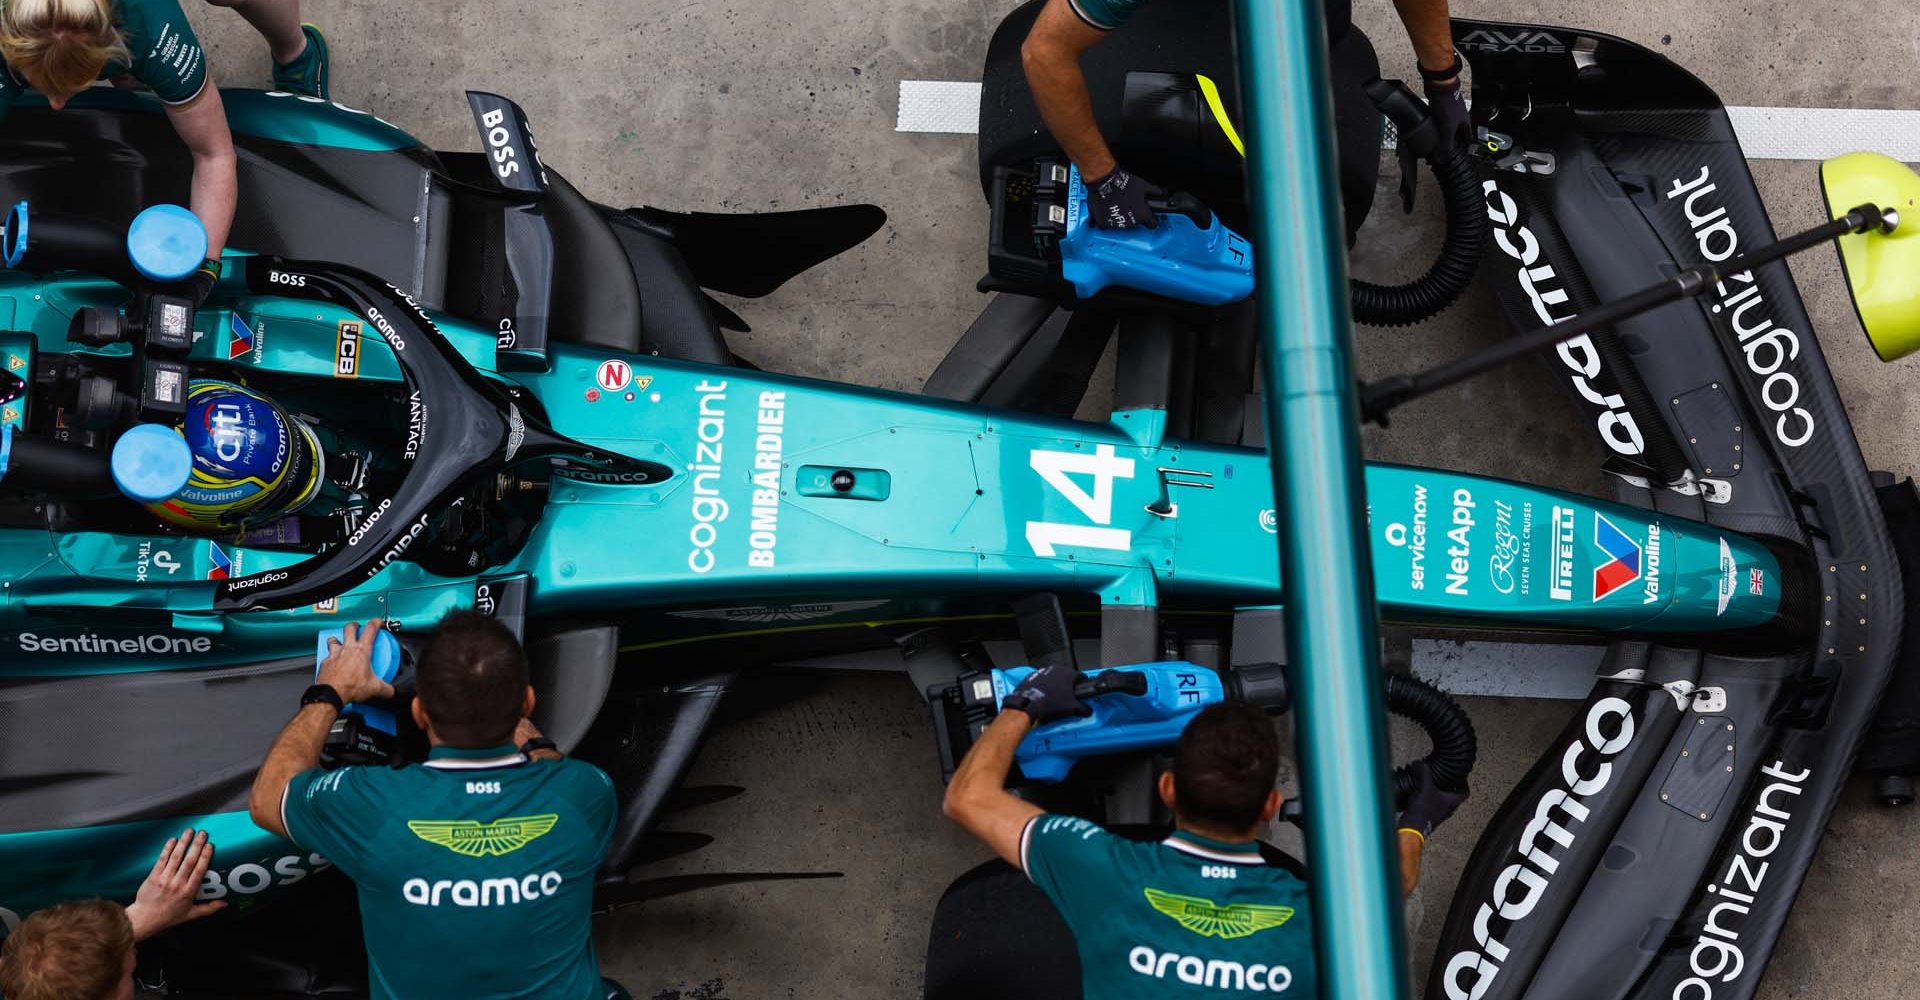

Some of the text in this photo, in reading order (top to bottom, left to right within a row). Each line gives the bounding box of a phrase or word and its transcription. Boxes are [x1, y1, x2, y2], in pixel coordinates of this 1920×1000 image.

[1456, 42, 1566, 53] TRADE
[1461, 30, 1563, 45] AVA
[482, 108, 519, 178] BOSS
[1227, 234, 1245, 267] LF
[270, 271, 306, 288] BOSS
[367, 307, 405, 351] aramco
[497, 317, 514, 348] citi
[1482, 179, 1645, 455] aramco
[253, 321, 265, 364] Valvoline
[339, 325, 357, 374] JCB
[605, 364, 624, 386] N
[214, 404, 241, 462] citi
[243, 403, 257, 465] Private Bank
[272, 410, 286, 473] aramco
[404, 390, 420, 460] VANTAGE
[554, 468, 649, 482] aramco
[688, 379, 728, 573] cognizant
[748, 391, 785, 568] BOMBARDIER
[348, 498, 391, 546] aramco
[1025, 443, 1136, 557] 14
[1411, 484, 1428, 591] servicenow
[1444, 488, 1477, 596] NetApp
[1489, 499, 1520, 595] Regent
[1521, 501, 1532, 595] SEVEN SEAS CRUISES
[1550, 505, 1575, 601] PIRELLI
[136, 541, 151, 583] TikTok
[228, 572, 288, 592] cognizant
[1643, 523, 1661, 605] Valvoline
[18, 632, 212, 654] SentinelOne
[1175, 673, 1199, 704] RF
[466, 782, 501, 794] BOSS
[453, 826, 520, 839] ASTON MARTIN
[1443, 697, 1635, 1000] aramco
[403, 870, 562, 906] aramco
[1201, 865, 1237, 879] BOSS
[1129, 946, 1292, 992] aramco
